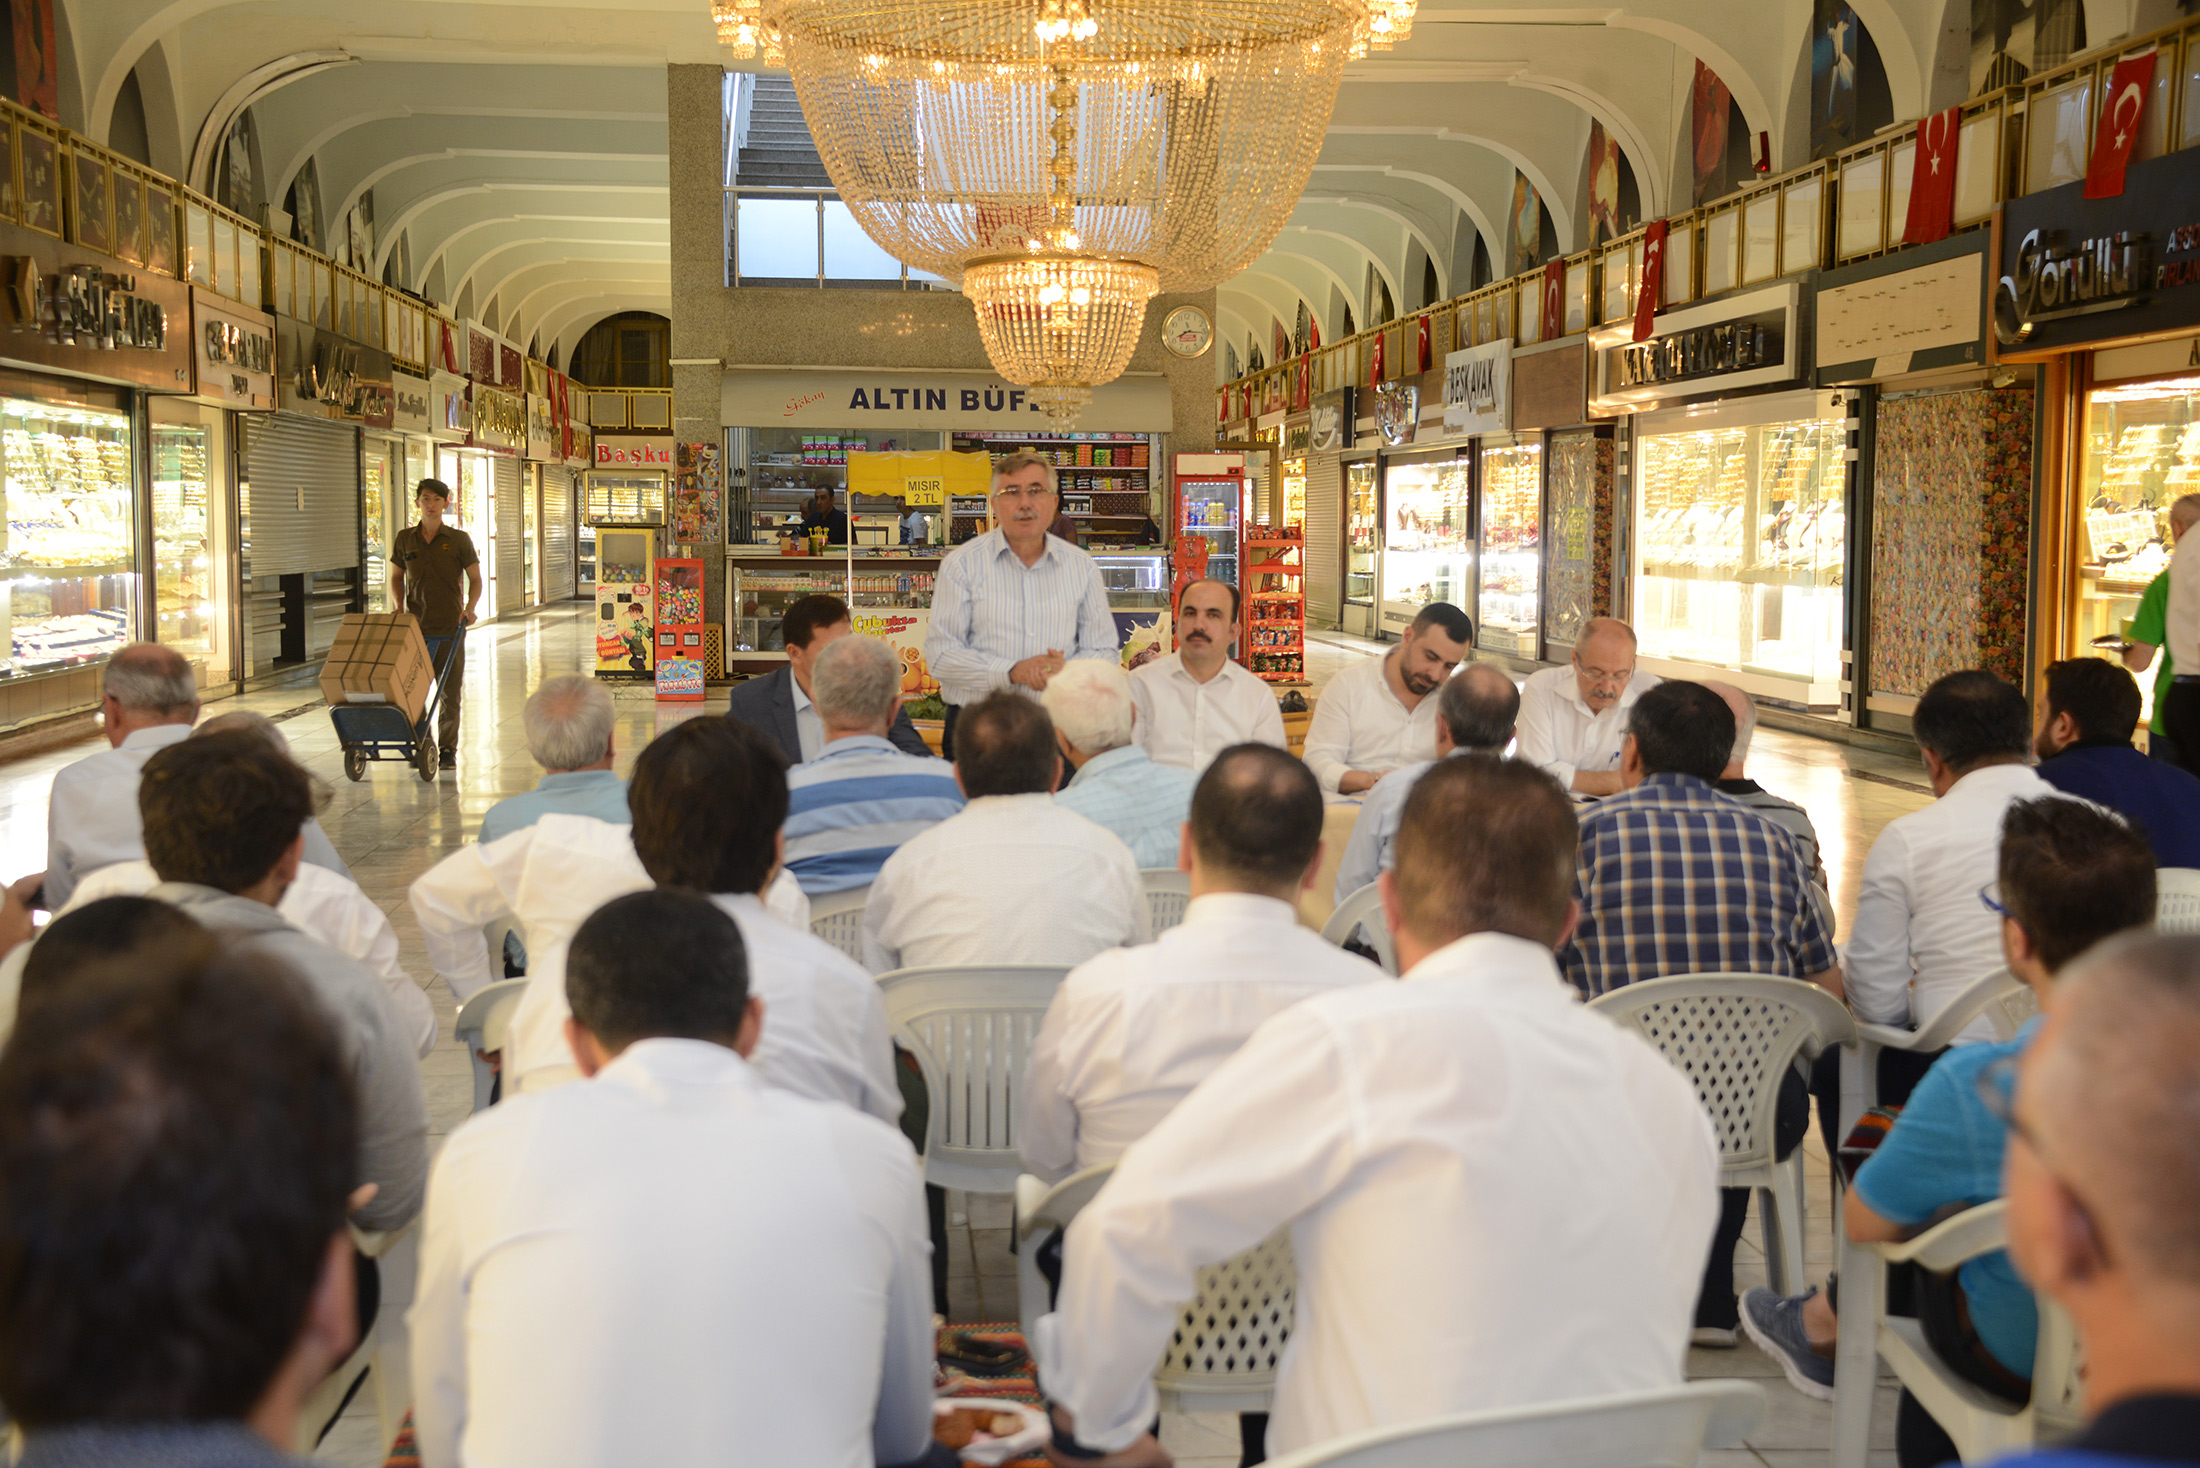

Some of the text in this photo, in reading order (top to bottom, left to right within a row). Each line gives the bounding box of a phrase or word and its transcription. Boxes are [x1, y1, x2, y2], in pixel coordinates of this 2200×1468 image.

[849, 387, 947, 411] ALTIN
[596, 443, 674, 468] Başku
[908, 480, 941, 491] MISIR
[914, 493, 938, 504] 2 TL
